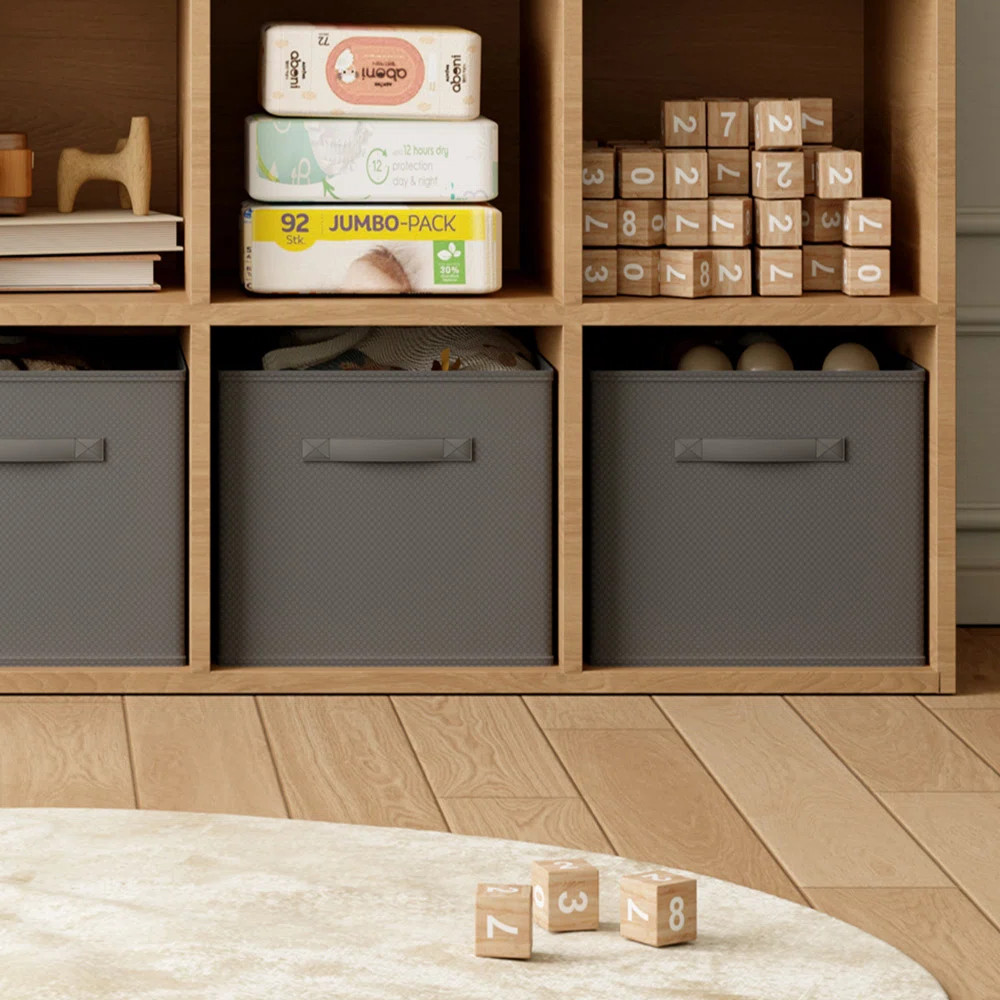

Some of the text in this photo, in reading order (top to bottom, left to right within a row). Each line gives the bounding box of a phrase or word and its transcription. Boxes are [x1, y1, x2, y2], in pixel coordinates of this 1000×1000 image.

[317, 36, 330, 47] 72
[673, 115, 697, 133] 2
[720, 112, 736, 137] 7
[768, 114, 793, 133] 2
[413, 145, 434, 156] hours
[435, 145, 449, 158] dry
[372, 159, 383, 172] 12
[392, 161, 433, 171] protection
[717, 163, 741, 181] 7
[777, 161, 793, 188] 2
[631, 167, 655, 185] 0
[675, 166, 699, 185] 2
[829, 166, 853, 185] 2
[280, 212, 457, 233] 92 JUMBO-PACK
[585, 214, 609, 233] 7
[622, 210, 637, 237] 8
[676, 214, 699, 233] 7
[711, 214, 735, 232] 7
[768, 214, 793, 233] 2
[821, 211, 841, 229] 3
[858, 214, 883, 232] 7
[286, 234, 305, 245] Stk.
[584, 265, 609, 283] 3
[623, 263, 644, 281] 0
[666, 264, 686, 283] 7
[700, 261, 710, 287] 8
[718, 264, 743, 282] 2
[769, 264, 794, 282] 7
[811, 260, 835, 277] 7
[857, 264, 882, 282] 0
[558, 890, 588, 914] 3
[627, 898, 649, 922] 7
[668, 896, 685, 932] 8
[486, 914, 519, 939] 7
